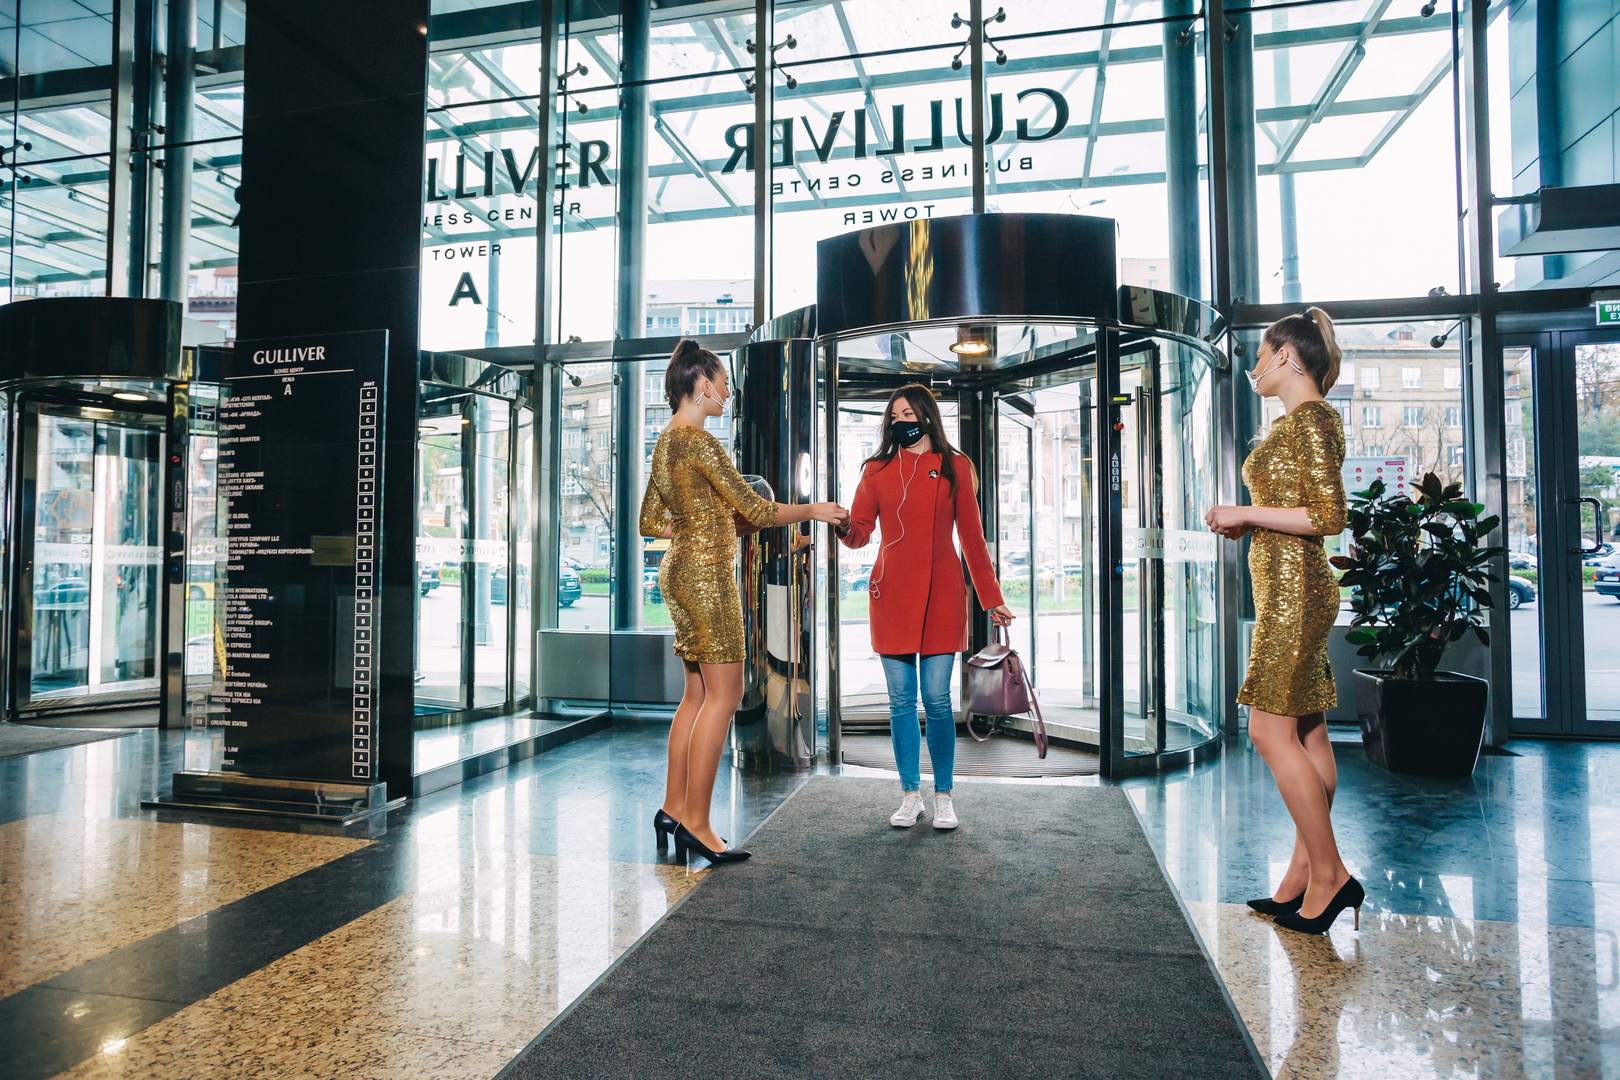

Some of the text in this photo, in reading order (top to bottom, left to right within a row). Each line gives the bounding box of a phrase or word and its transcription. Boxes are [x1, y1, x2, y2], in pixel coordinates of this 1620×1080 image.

[427, 139, 613, 204] LLIVER
[487, 202, 582, 222] CENER
[432, 244, 502, 261] TOWER
[448, 271, 483, 306] A
[253, 346, 326, 365] GULLIVER
